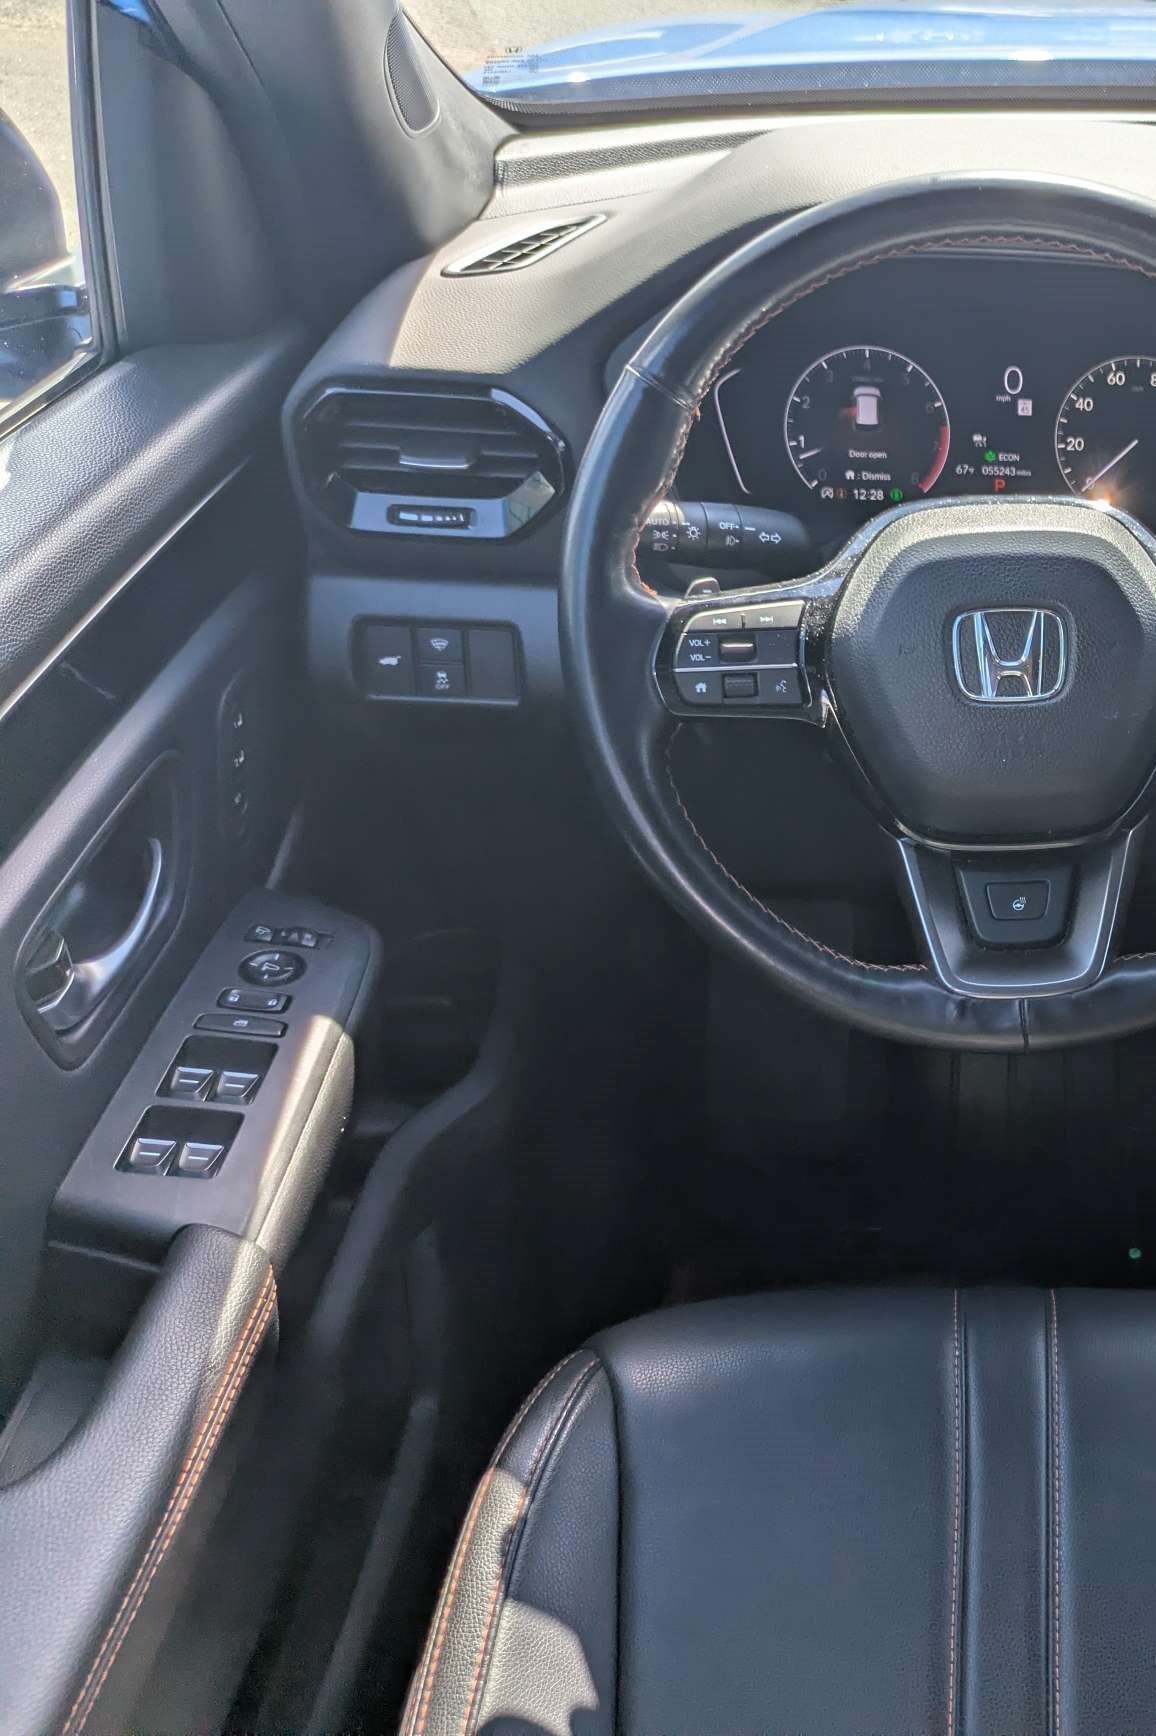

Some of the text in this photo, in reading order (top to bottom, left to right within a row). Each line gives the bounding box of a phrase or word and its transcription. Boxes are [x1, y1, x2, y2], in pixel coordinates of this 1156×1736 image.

[1003, 365, 1024, 395] 0
[1107, 373, 1126, 386] 60
[802, 396, 811, 409] 2
[1075, 398, 1094, 412] 40
[798, 435, 805, 448] 1
[1066, 437, 1085, 451] 20
[849, 450, 888, 460] Door open
[998, 452, 1020, 462] ECON
[861, 471, 892, 481] Dismiss
[982, 465, 1016, 476] 055243
[853, 488, 885, 501] 12:28
[719, 521, 735, 530] OFF
